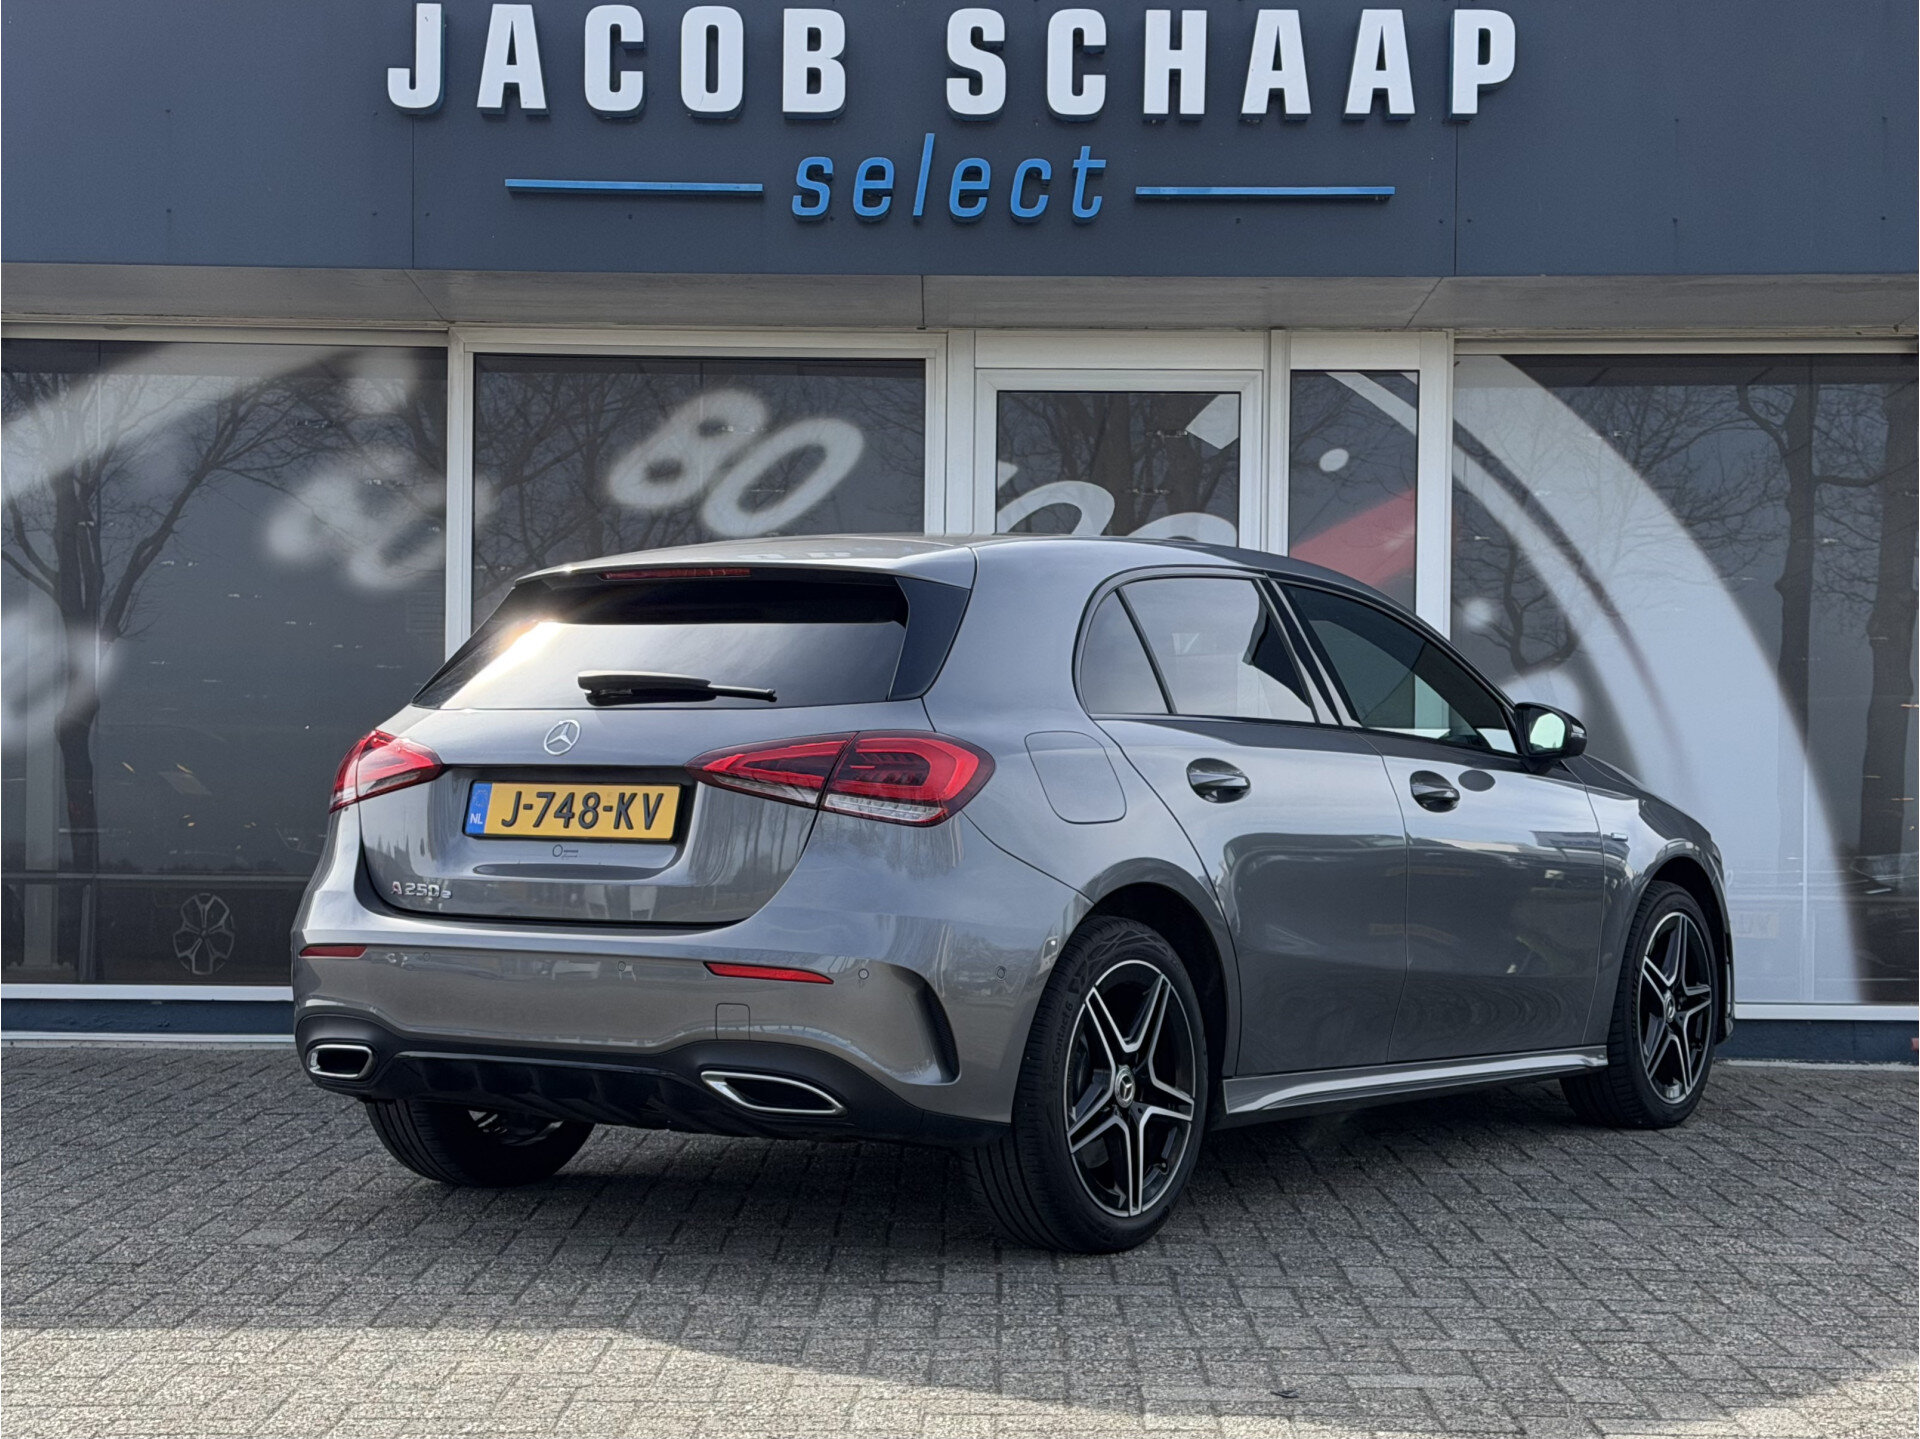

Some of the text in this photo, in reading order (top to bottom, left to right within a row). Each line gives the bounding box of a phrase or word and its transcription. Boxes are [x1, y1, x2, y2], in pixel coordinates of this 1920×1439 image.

[387, 2, 1518, 120] JACOB SCHAAP
[791, 133, 1108, 222] select
[469, 813, 483, 826] NL
[501, 792, 664, 829] J-748-KV
[391, 881, 403, 895] A
